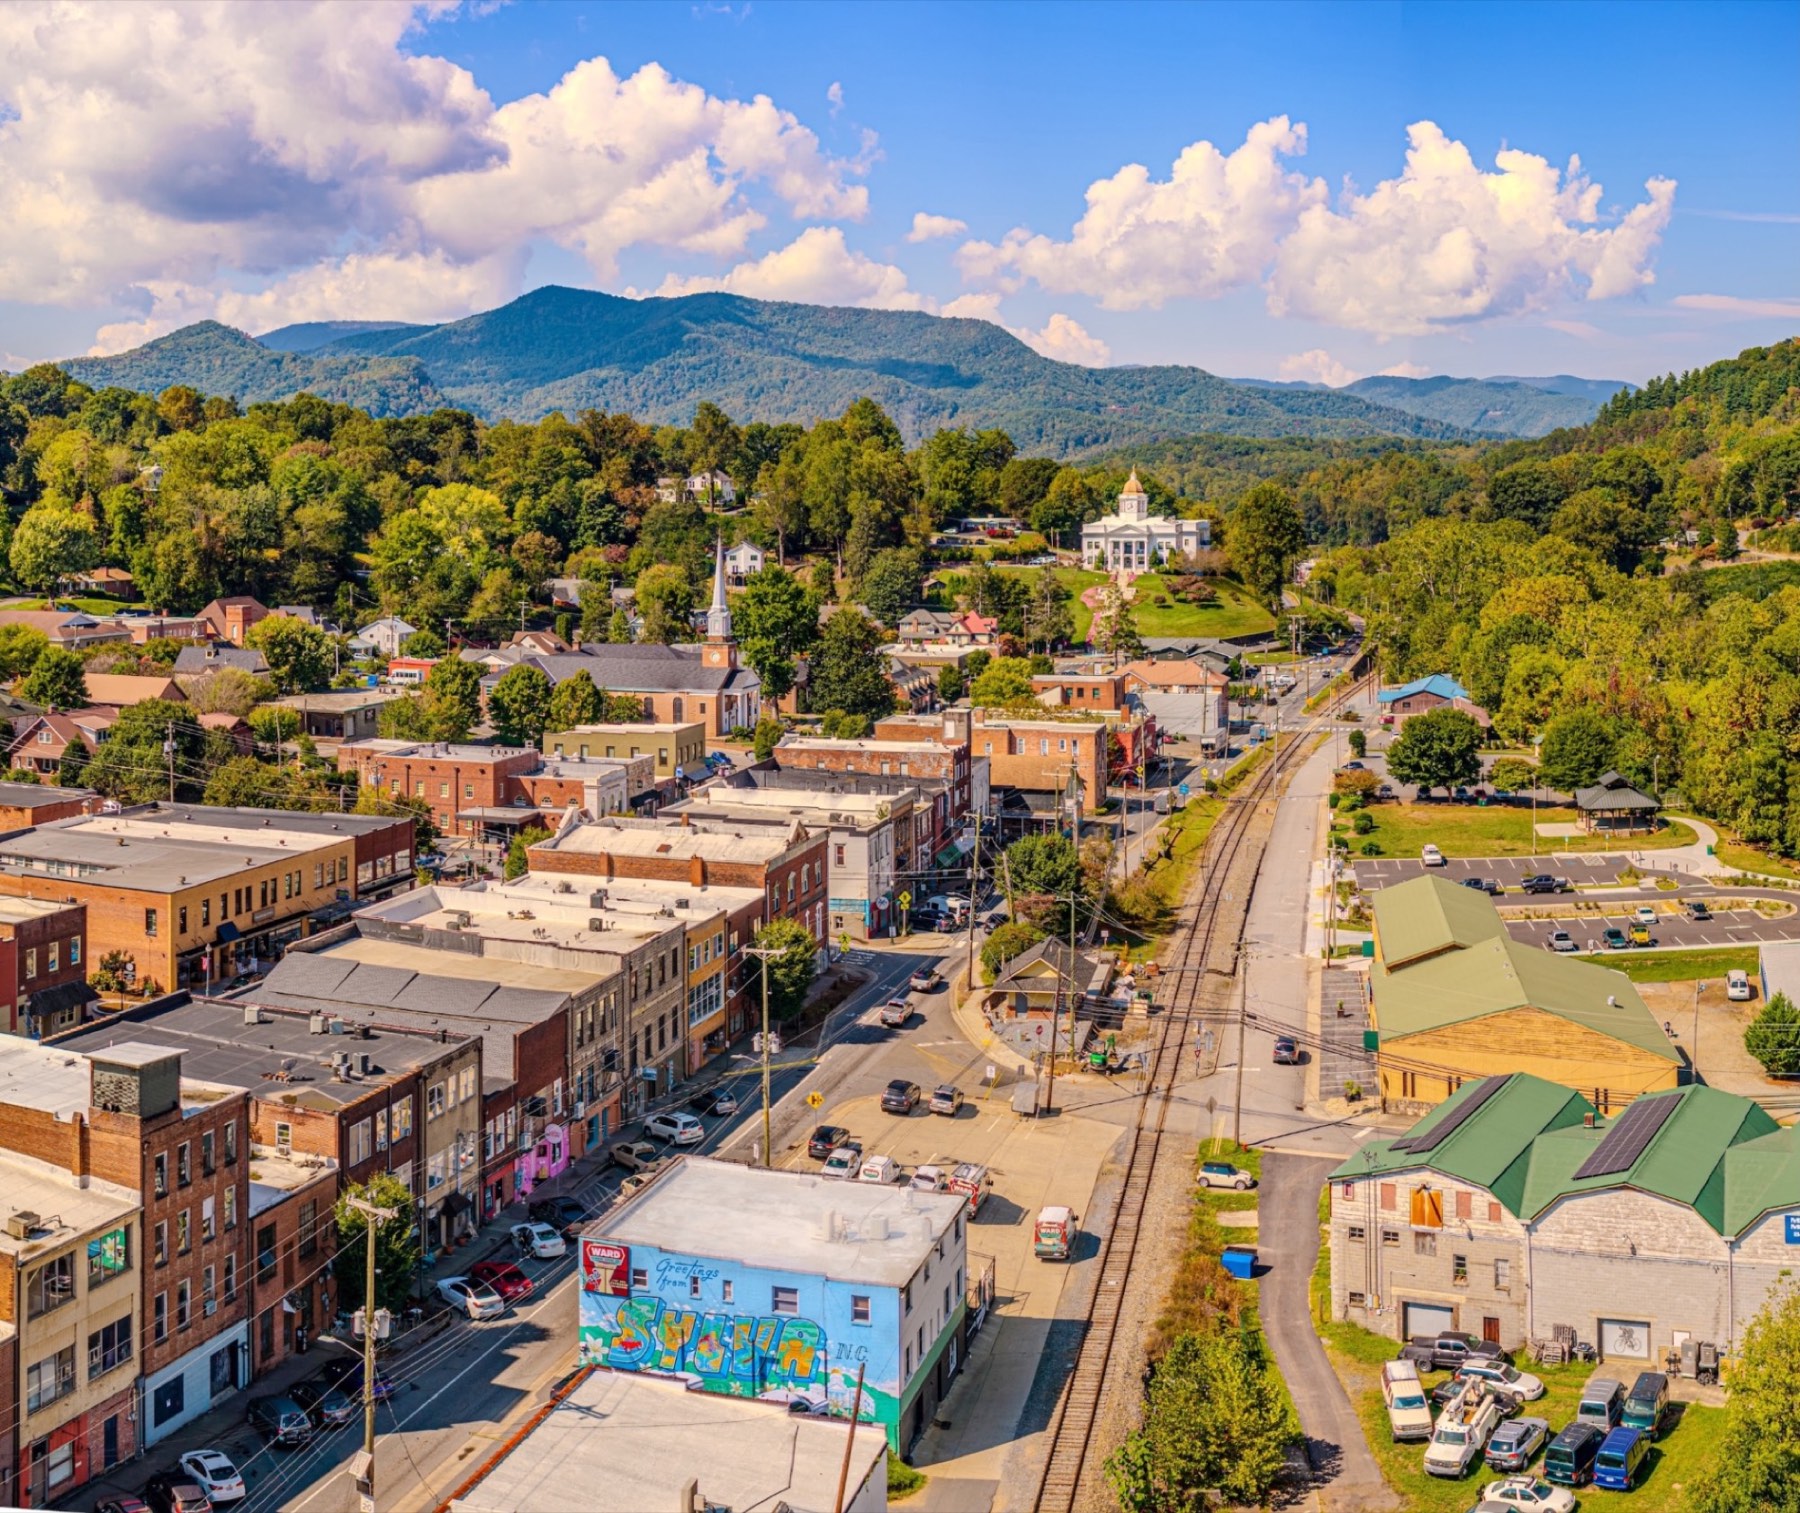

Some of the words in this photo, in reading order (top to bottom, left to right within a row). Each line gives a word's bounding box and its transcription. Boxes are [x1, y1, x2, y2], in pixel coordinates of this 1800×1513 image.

[591, 1246, 621, 1259] WARD
[656, 1258, 719, 1284] Greetings
[658, 1276, 688, 1292] from
[607, 1296, 826, 1382] SYLVA
[836, 1342, 869, 1362] N.C.
